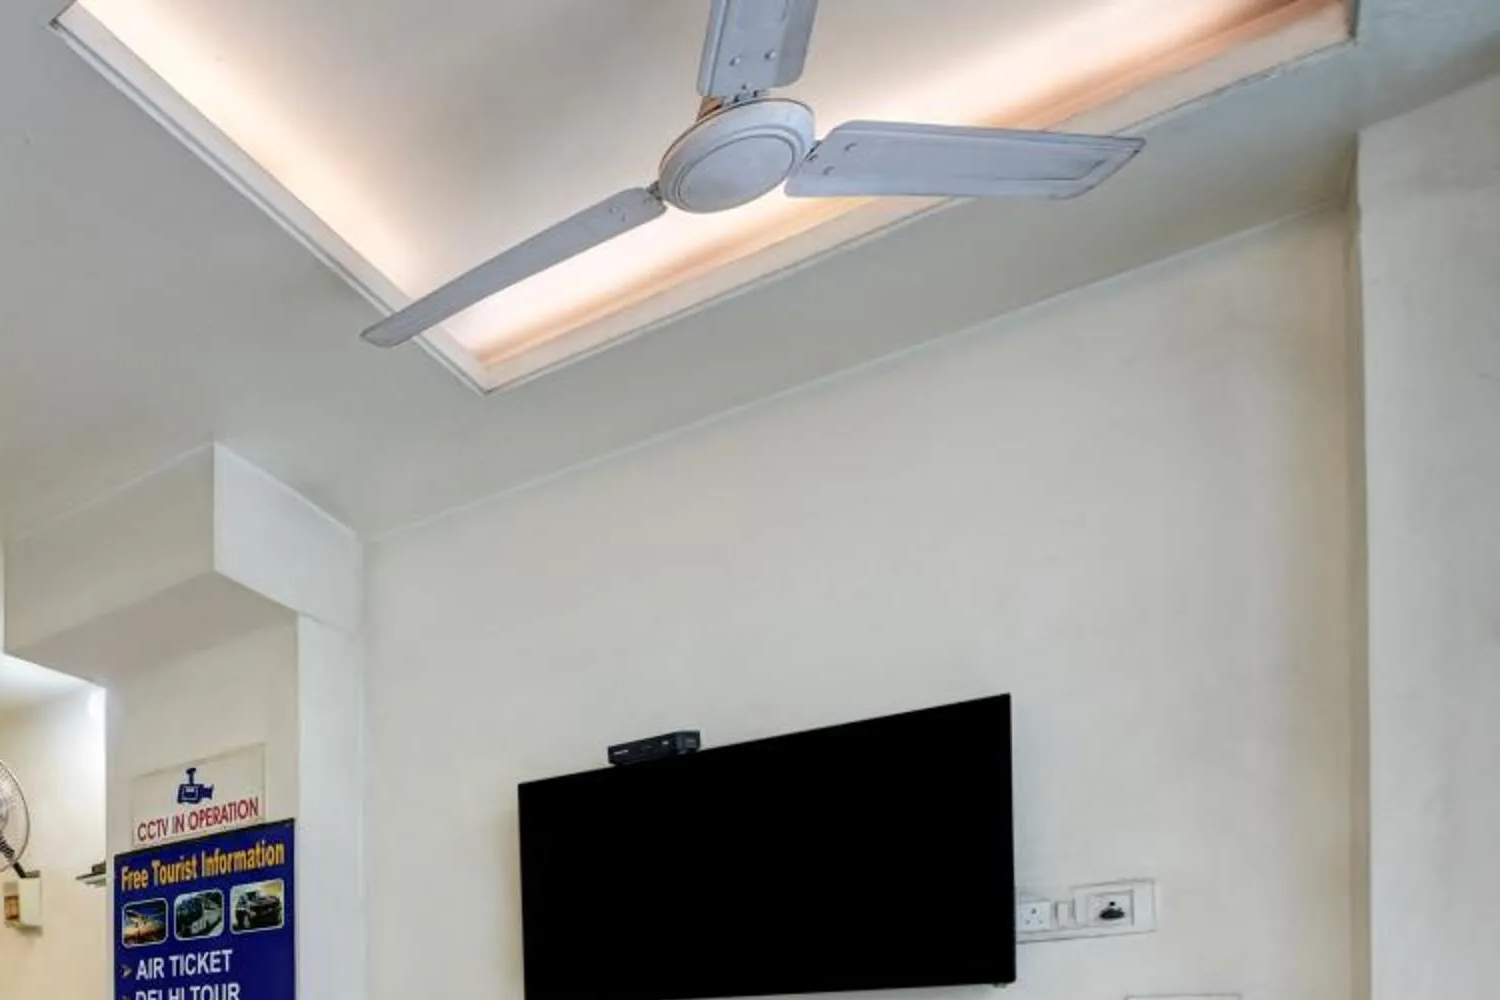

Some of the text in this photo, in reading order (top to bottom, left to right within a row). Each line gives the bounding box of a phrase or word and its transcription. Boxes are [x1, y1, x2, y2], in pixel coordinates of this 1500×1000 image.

[137, 796, 258, 841] CCTV IN OPERATION
[121, 840, 285, 892] Free Tourist Information
[135, 949, 233, 980] AIR TICKET
